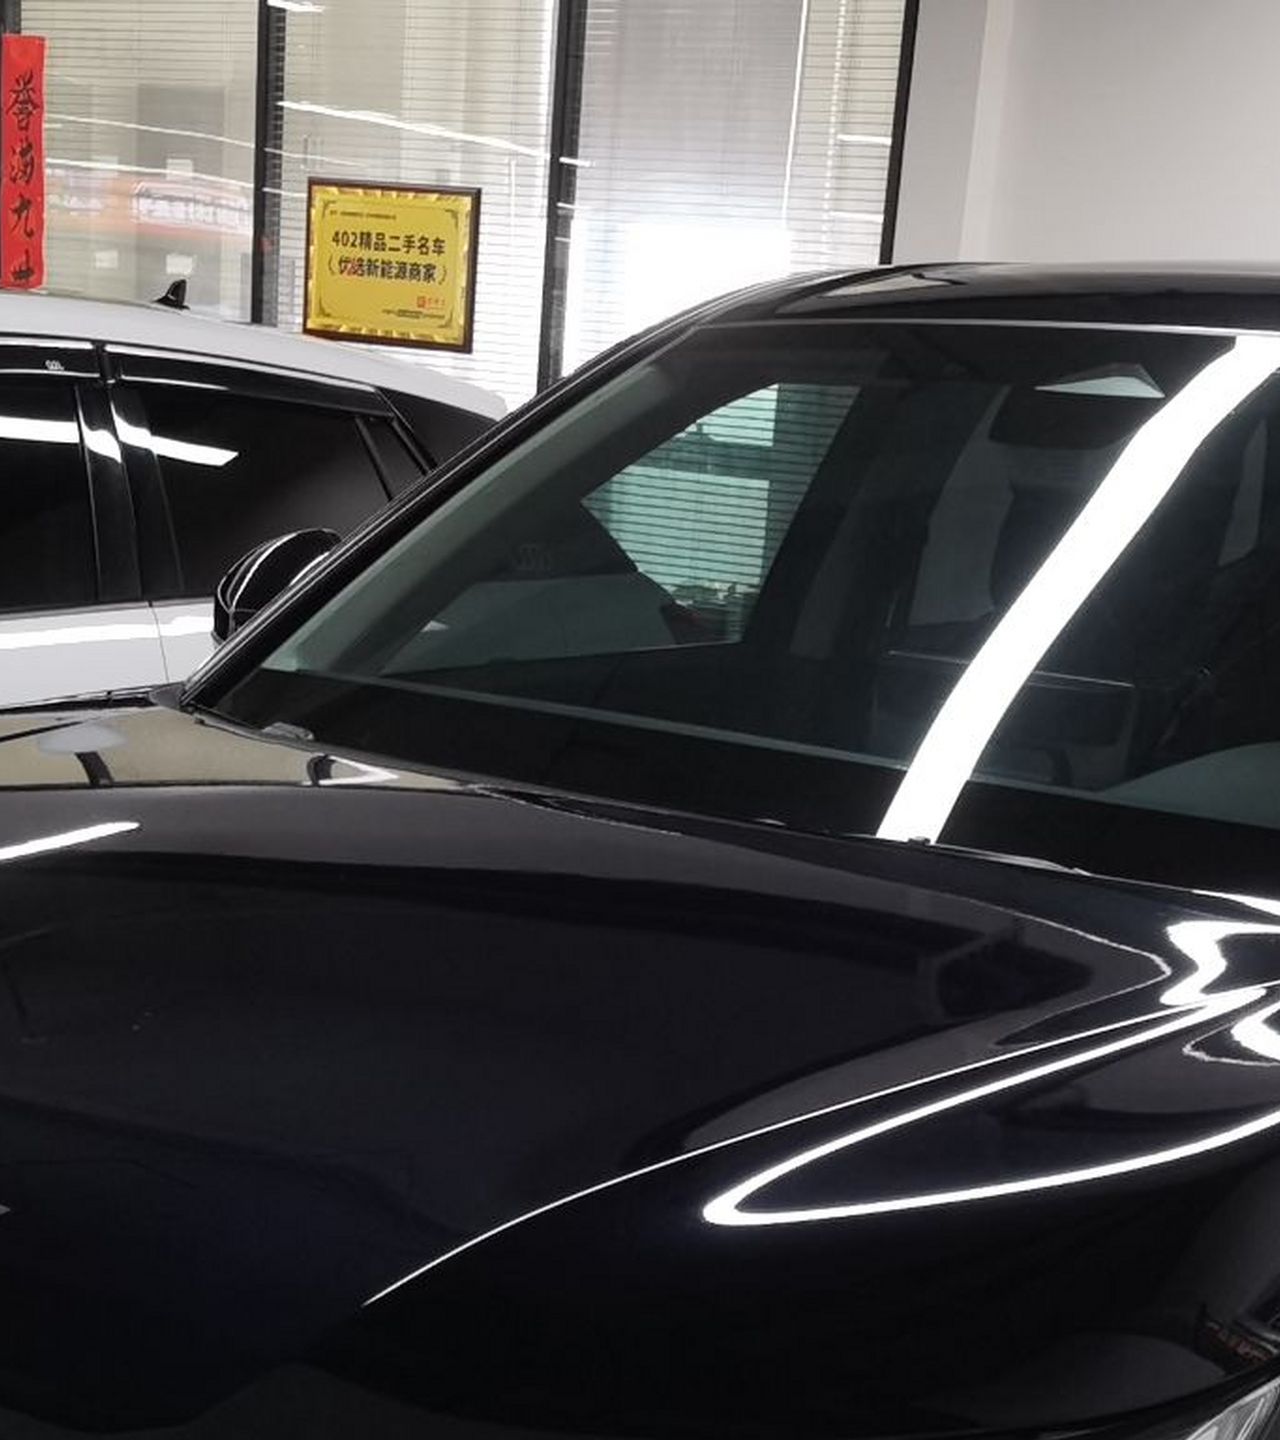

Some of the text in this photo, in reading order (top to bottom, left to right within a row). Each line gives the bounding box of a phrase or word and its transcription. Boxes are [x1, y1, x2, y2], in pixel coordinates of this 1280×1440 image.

[331, 230, 446, 257] 402精品二手名车
